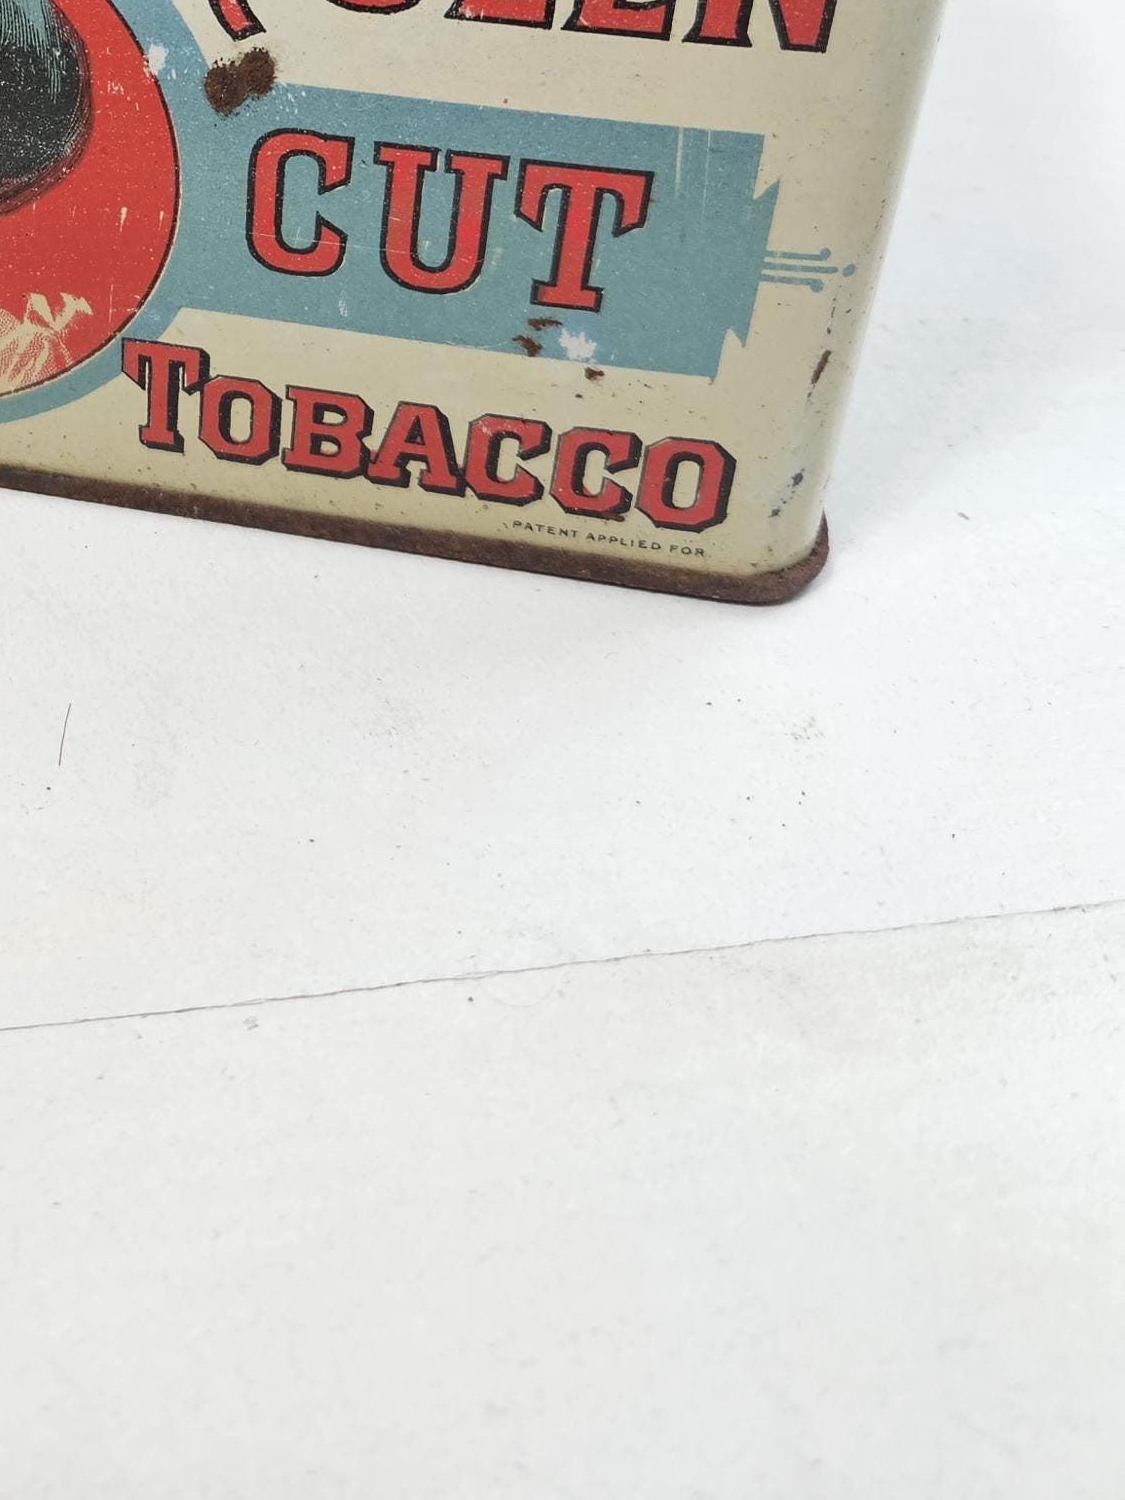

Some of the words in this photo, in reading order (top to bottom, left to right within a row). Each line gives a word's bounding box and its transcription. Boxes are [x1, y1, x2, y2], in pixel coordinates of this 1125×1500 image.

[244, 126, 655, 313] CUT
[120, 336, 737, 534] TOBACCO
[511, 519, 579, 539] PATENT
[585, 531, 662, 551] APPLIED
